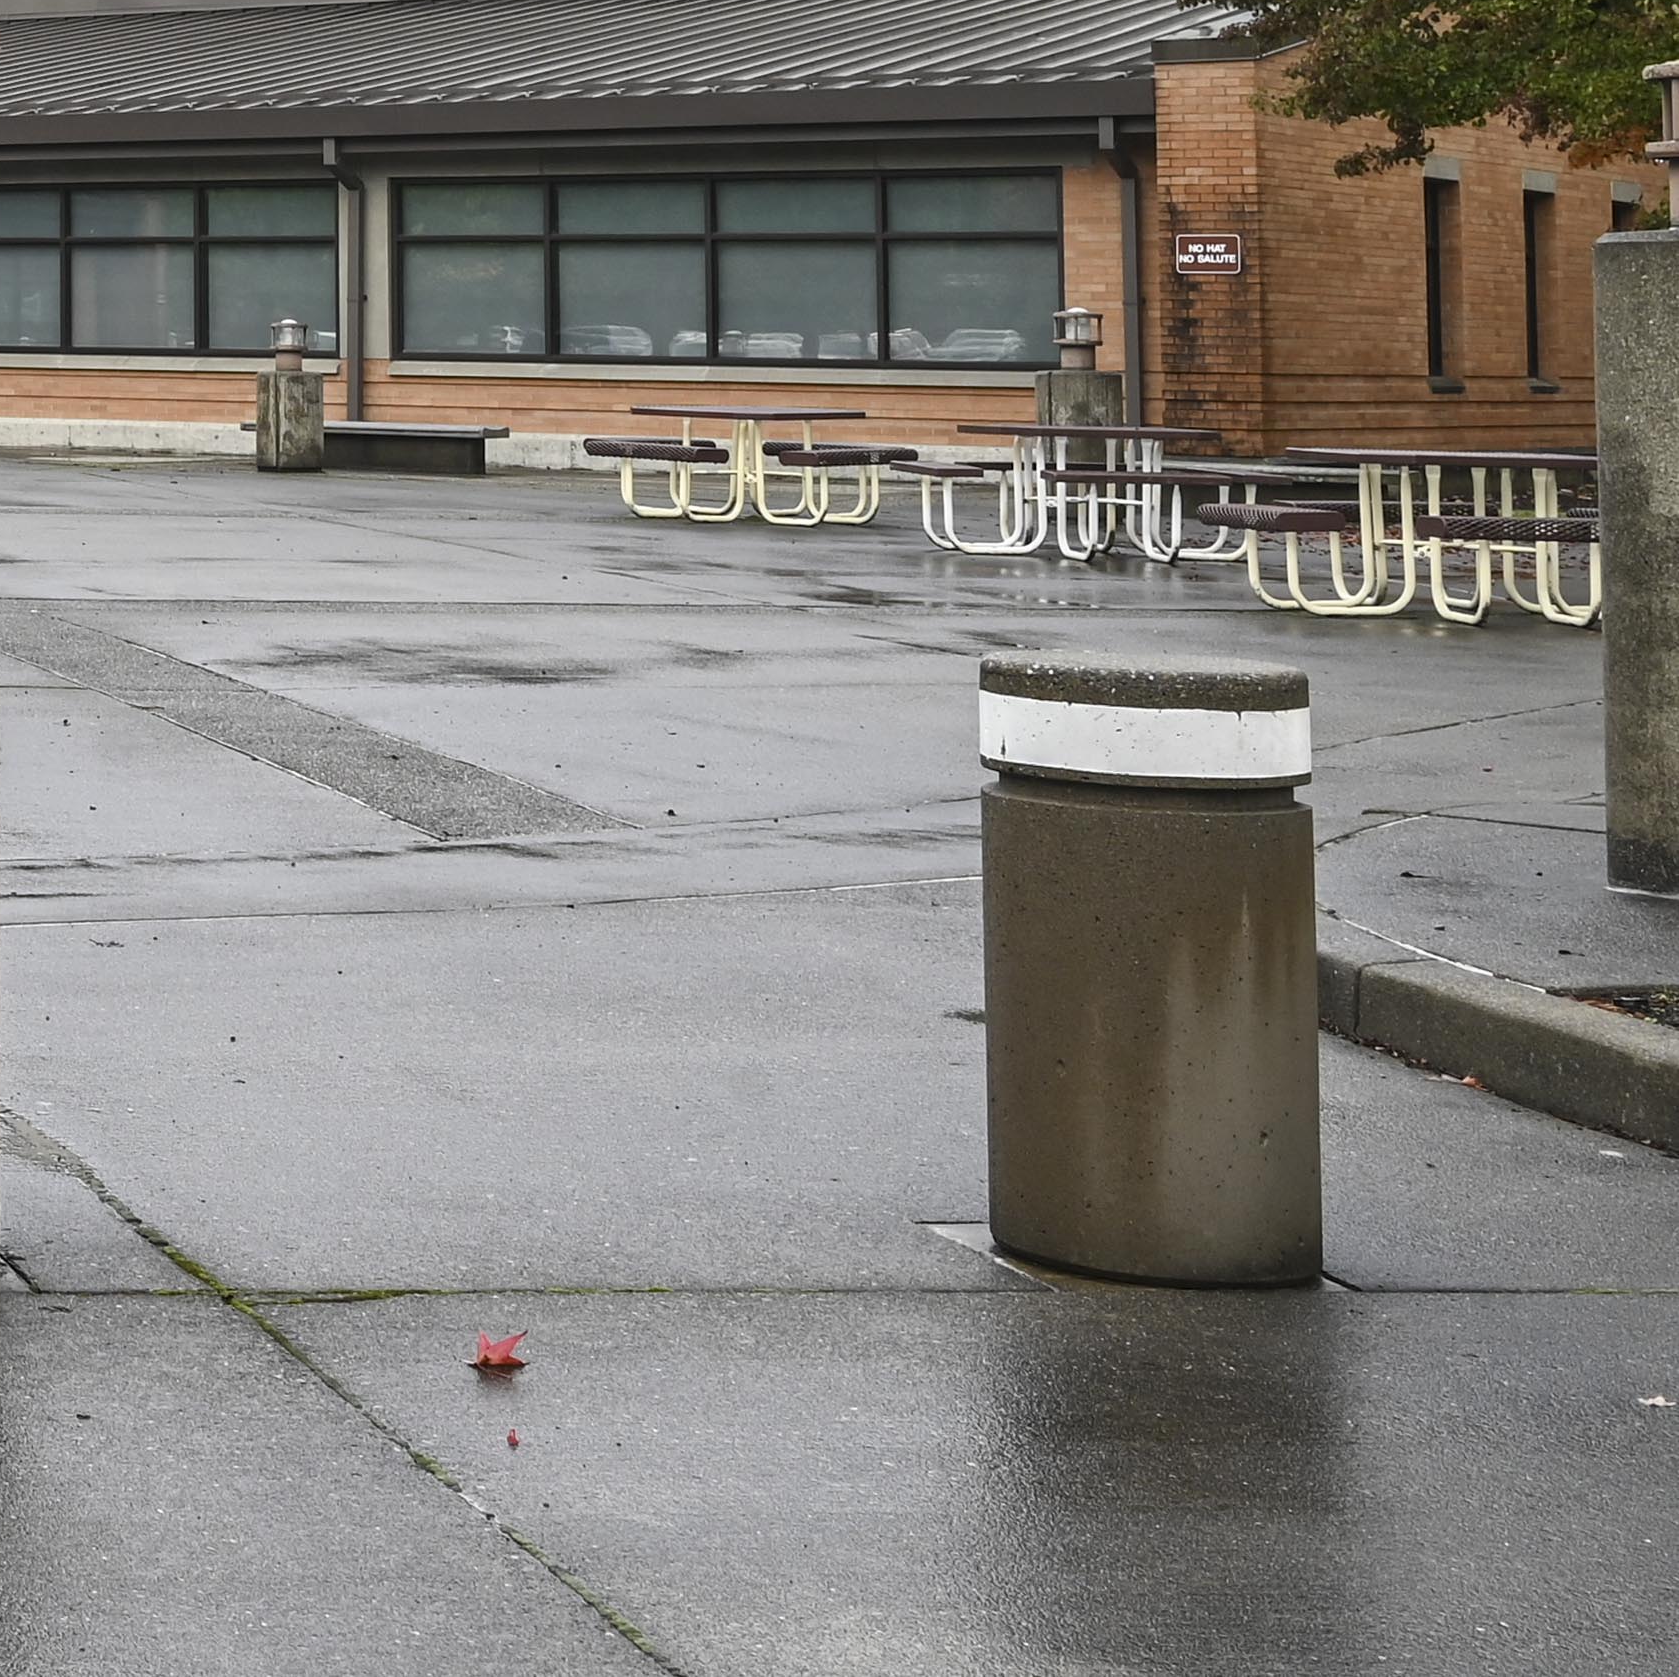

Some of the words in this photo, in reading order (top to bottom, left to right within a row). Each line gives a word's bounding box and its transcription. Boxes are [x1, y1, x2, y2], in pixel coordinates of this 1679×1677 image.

[1188, 244, 1204, 253] NO
[1206, 244, 1226, 253] HAT
[1179, 254, 1195, 263] NO
[1197, 254, 1236, 263] SALUTE
